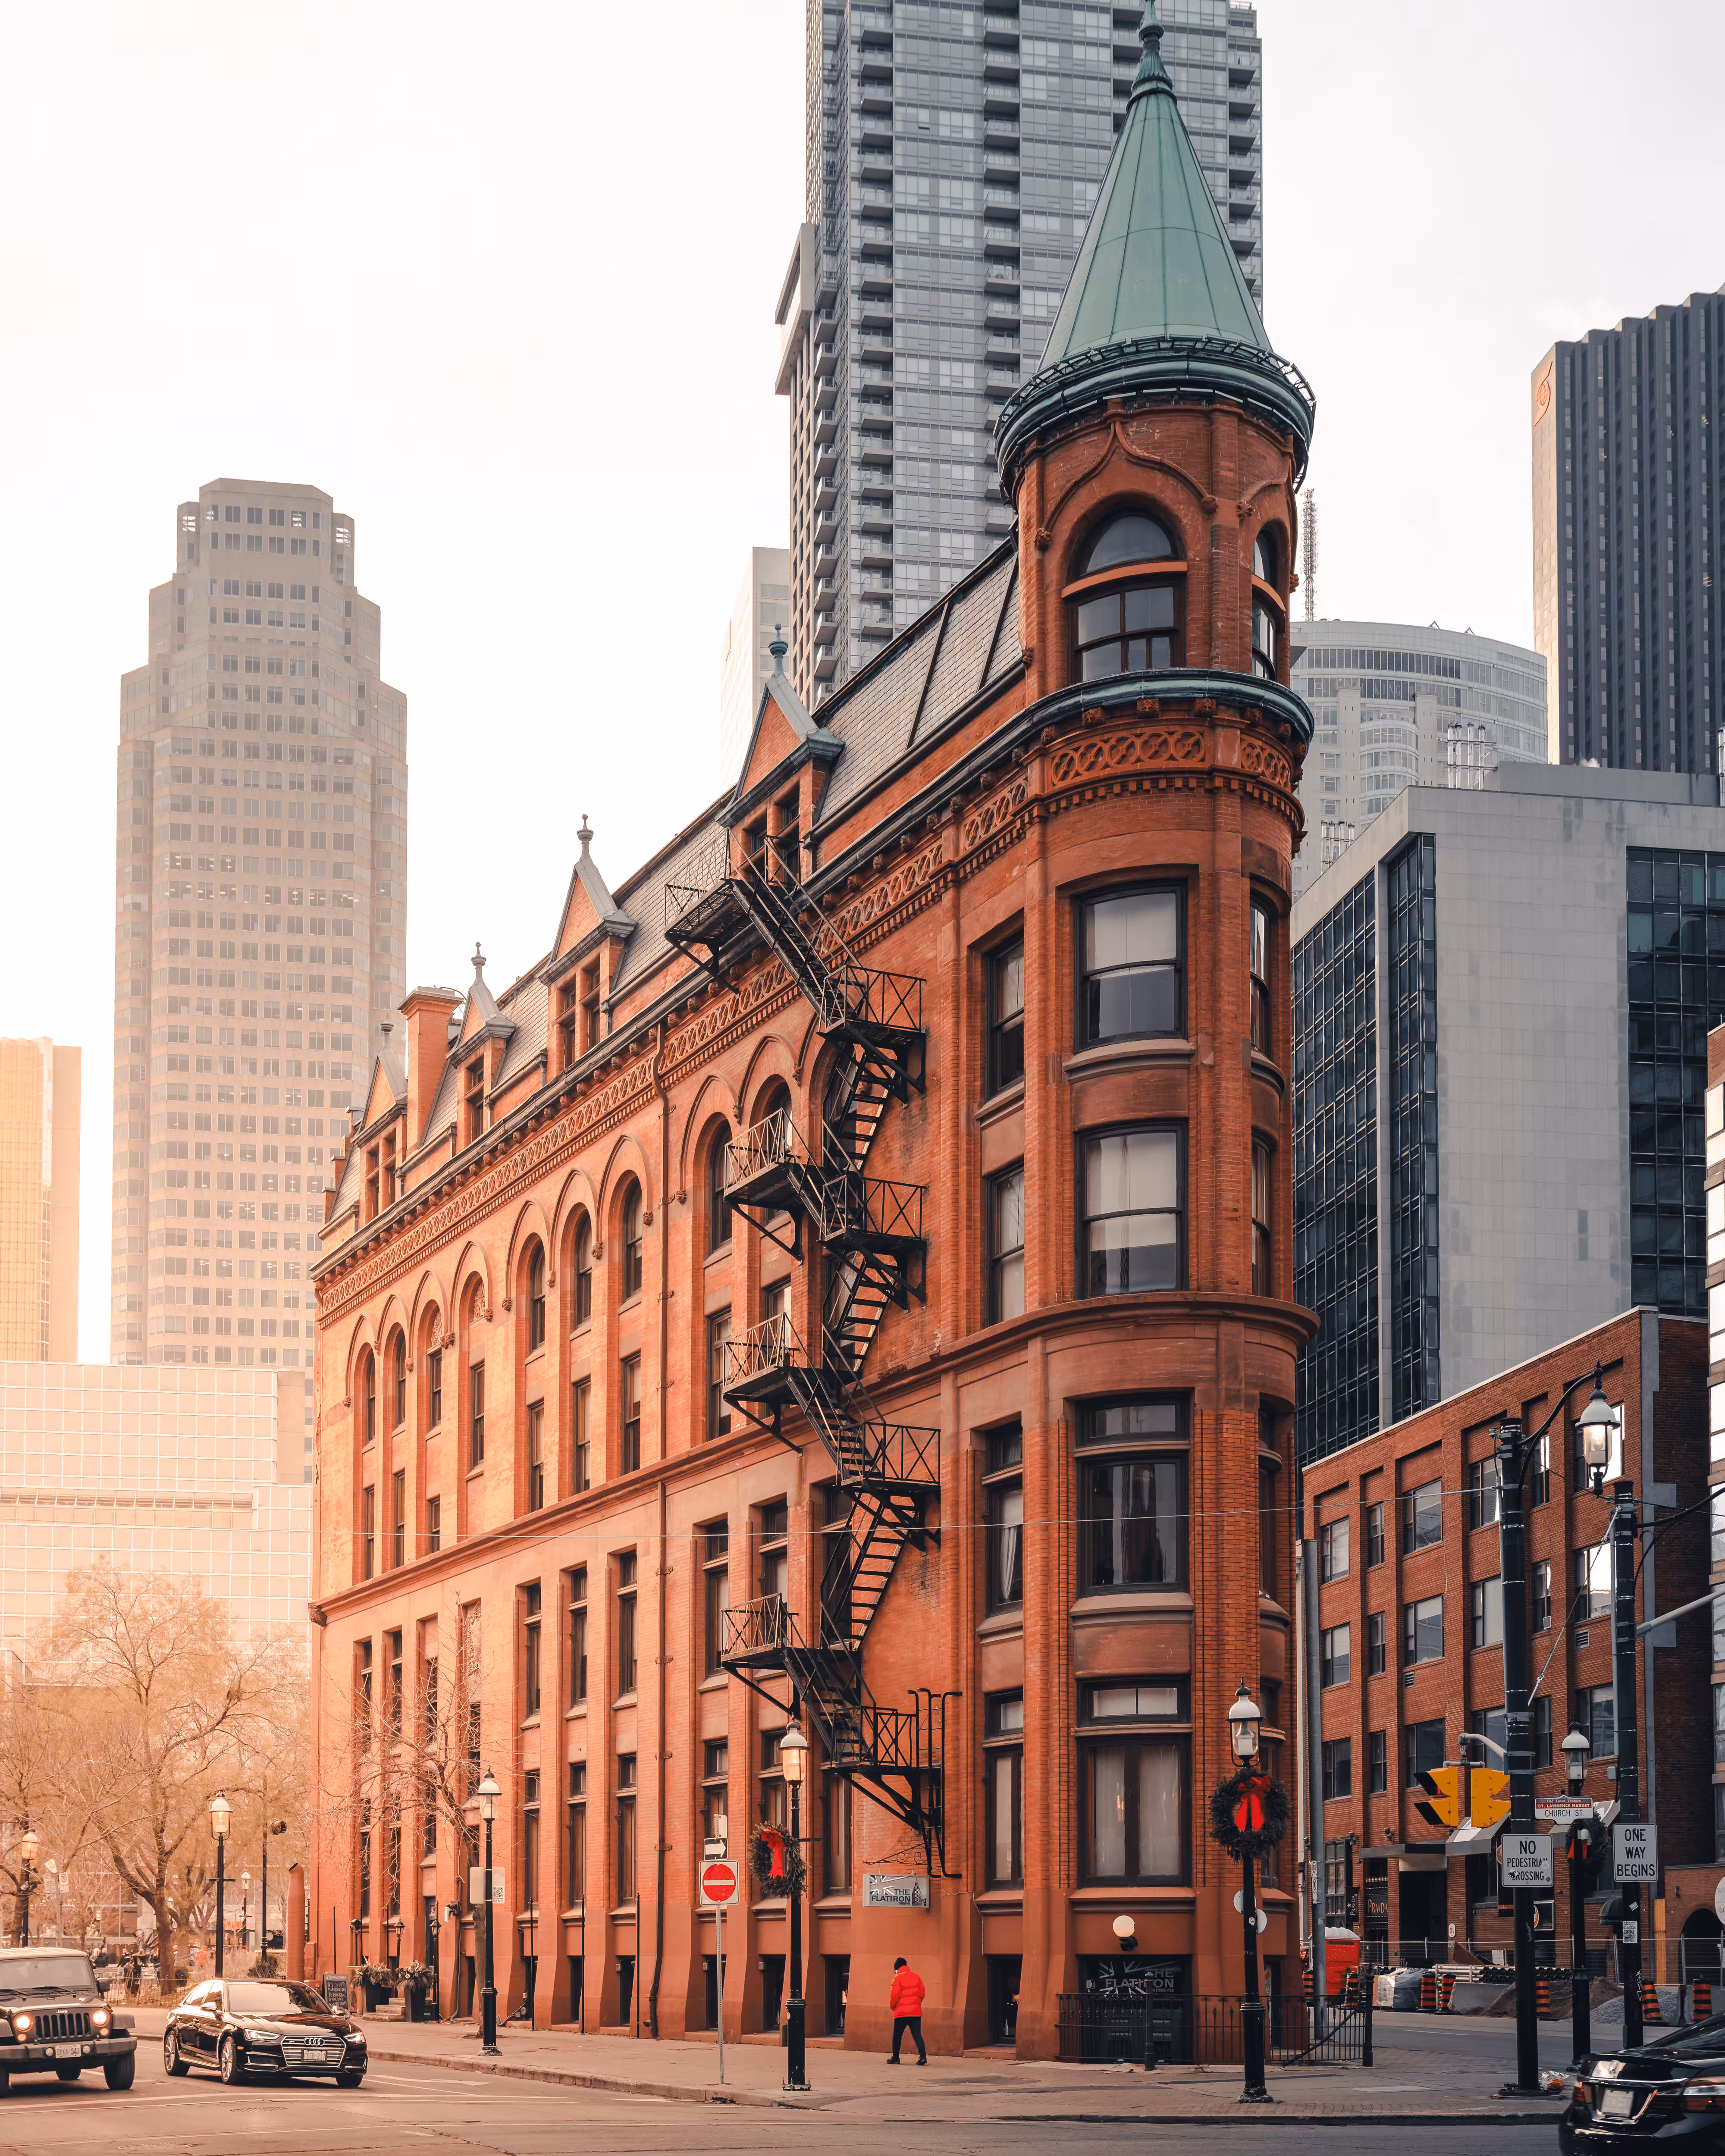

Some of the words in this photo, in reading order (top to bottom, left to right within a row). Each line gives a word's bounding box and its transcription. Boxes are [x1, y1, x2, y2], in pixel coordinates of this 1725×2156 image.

[1374, 683, 1401, 696] KING
[1625, 1829, 1646, 1841] ONE
[1519, 1840, 1536, 1855] NO
[1625, 1846, 1646, 1859] WAY
[1617, 1864, 1655, 1877] BEGINS
